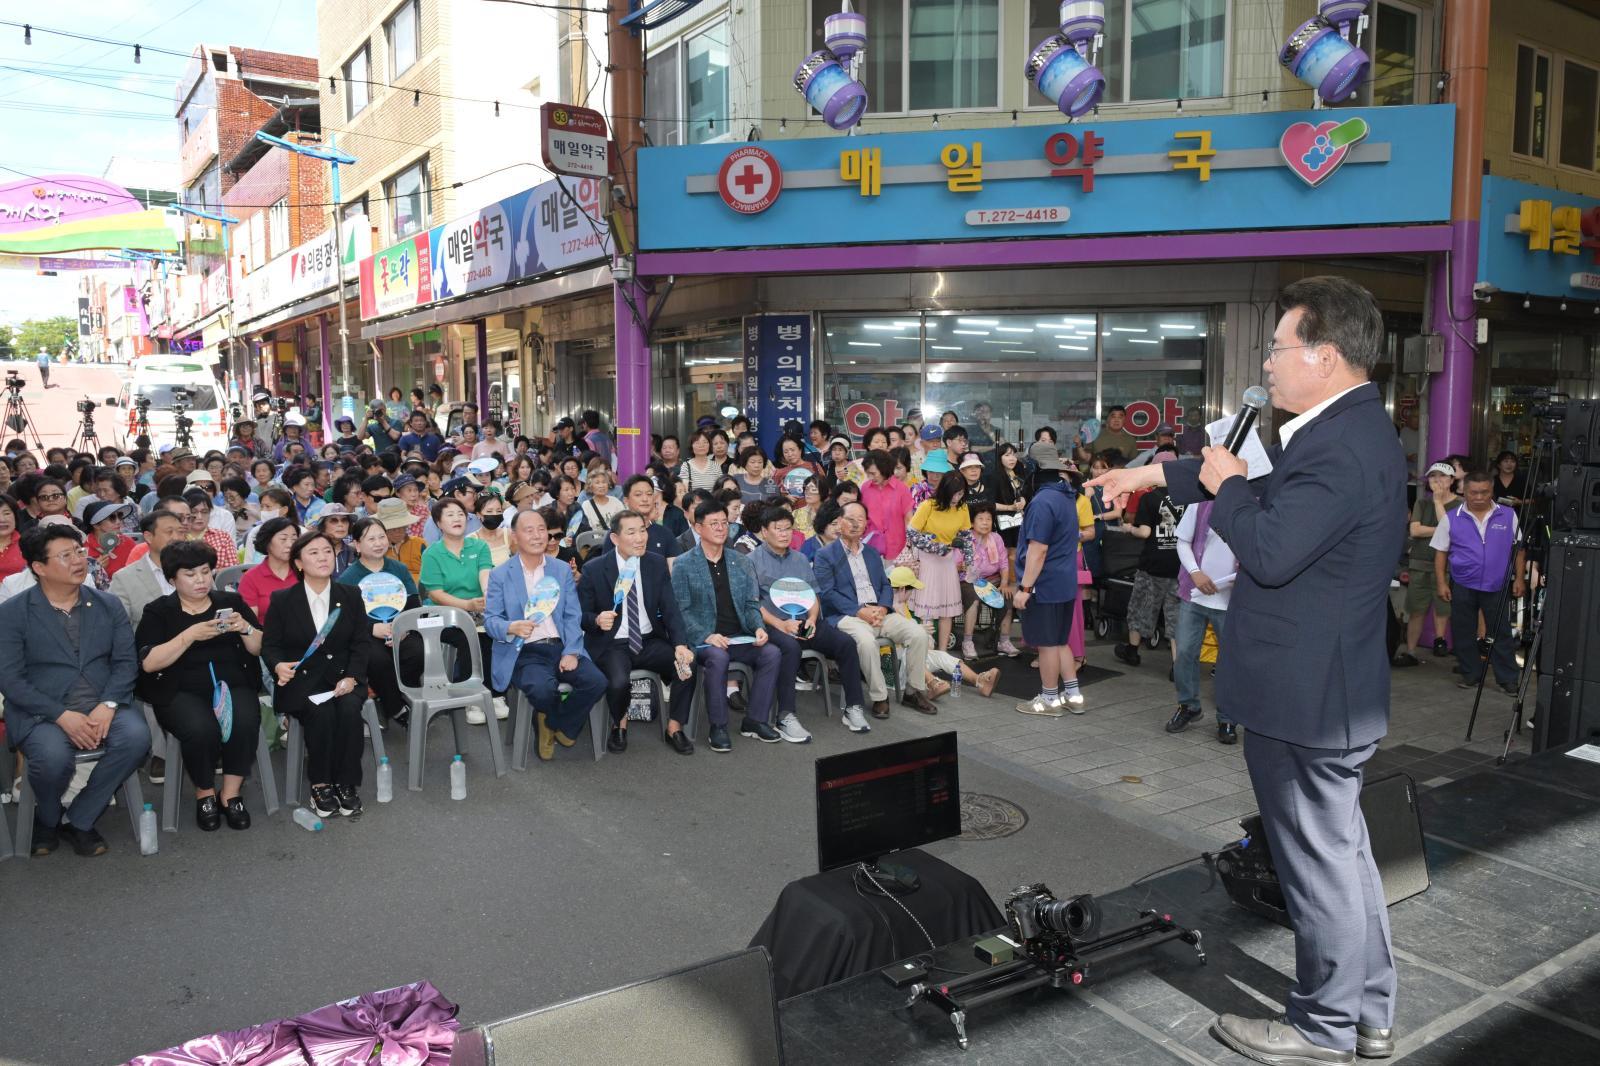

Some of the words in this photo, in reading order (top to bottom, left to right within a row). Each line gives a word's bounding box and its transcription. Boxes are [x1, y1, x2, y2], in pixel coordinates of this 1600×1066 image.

[554, 111, 567, 123] 93
[553, 139, 606, 160] 매일약국
[729, 148, 769, 162] PHARMACY
[567, 162, 594, 171] 272-4418
[840, 131, 1217, 196] 매일약국
[730, 197, 770, 211] PHARMACY
[977, 209, 1058, 224] T.272-4418
[447, 214, 505, 264] 매일약국
